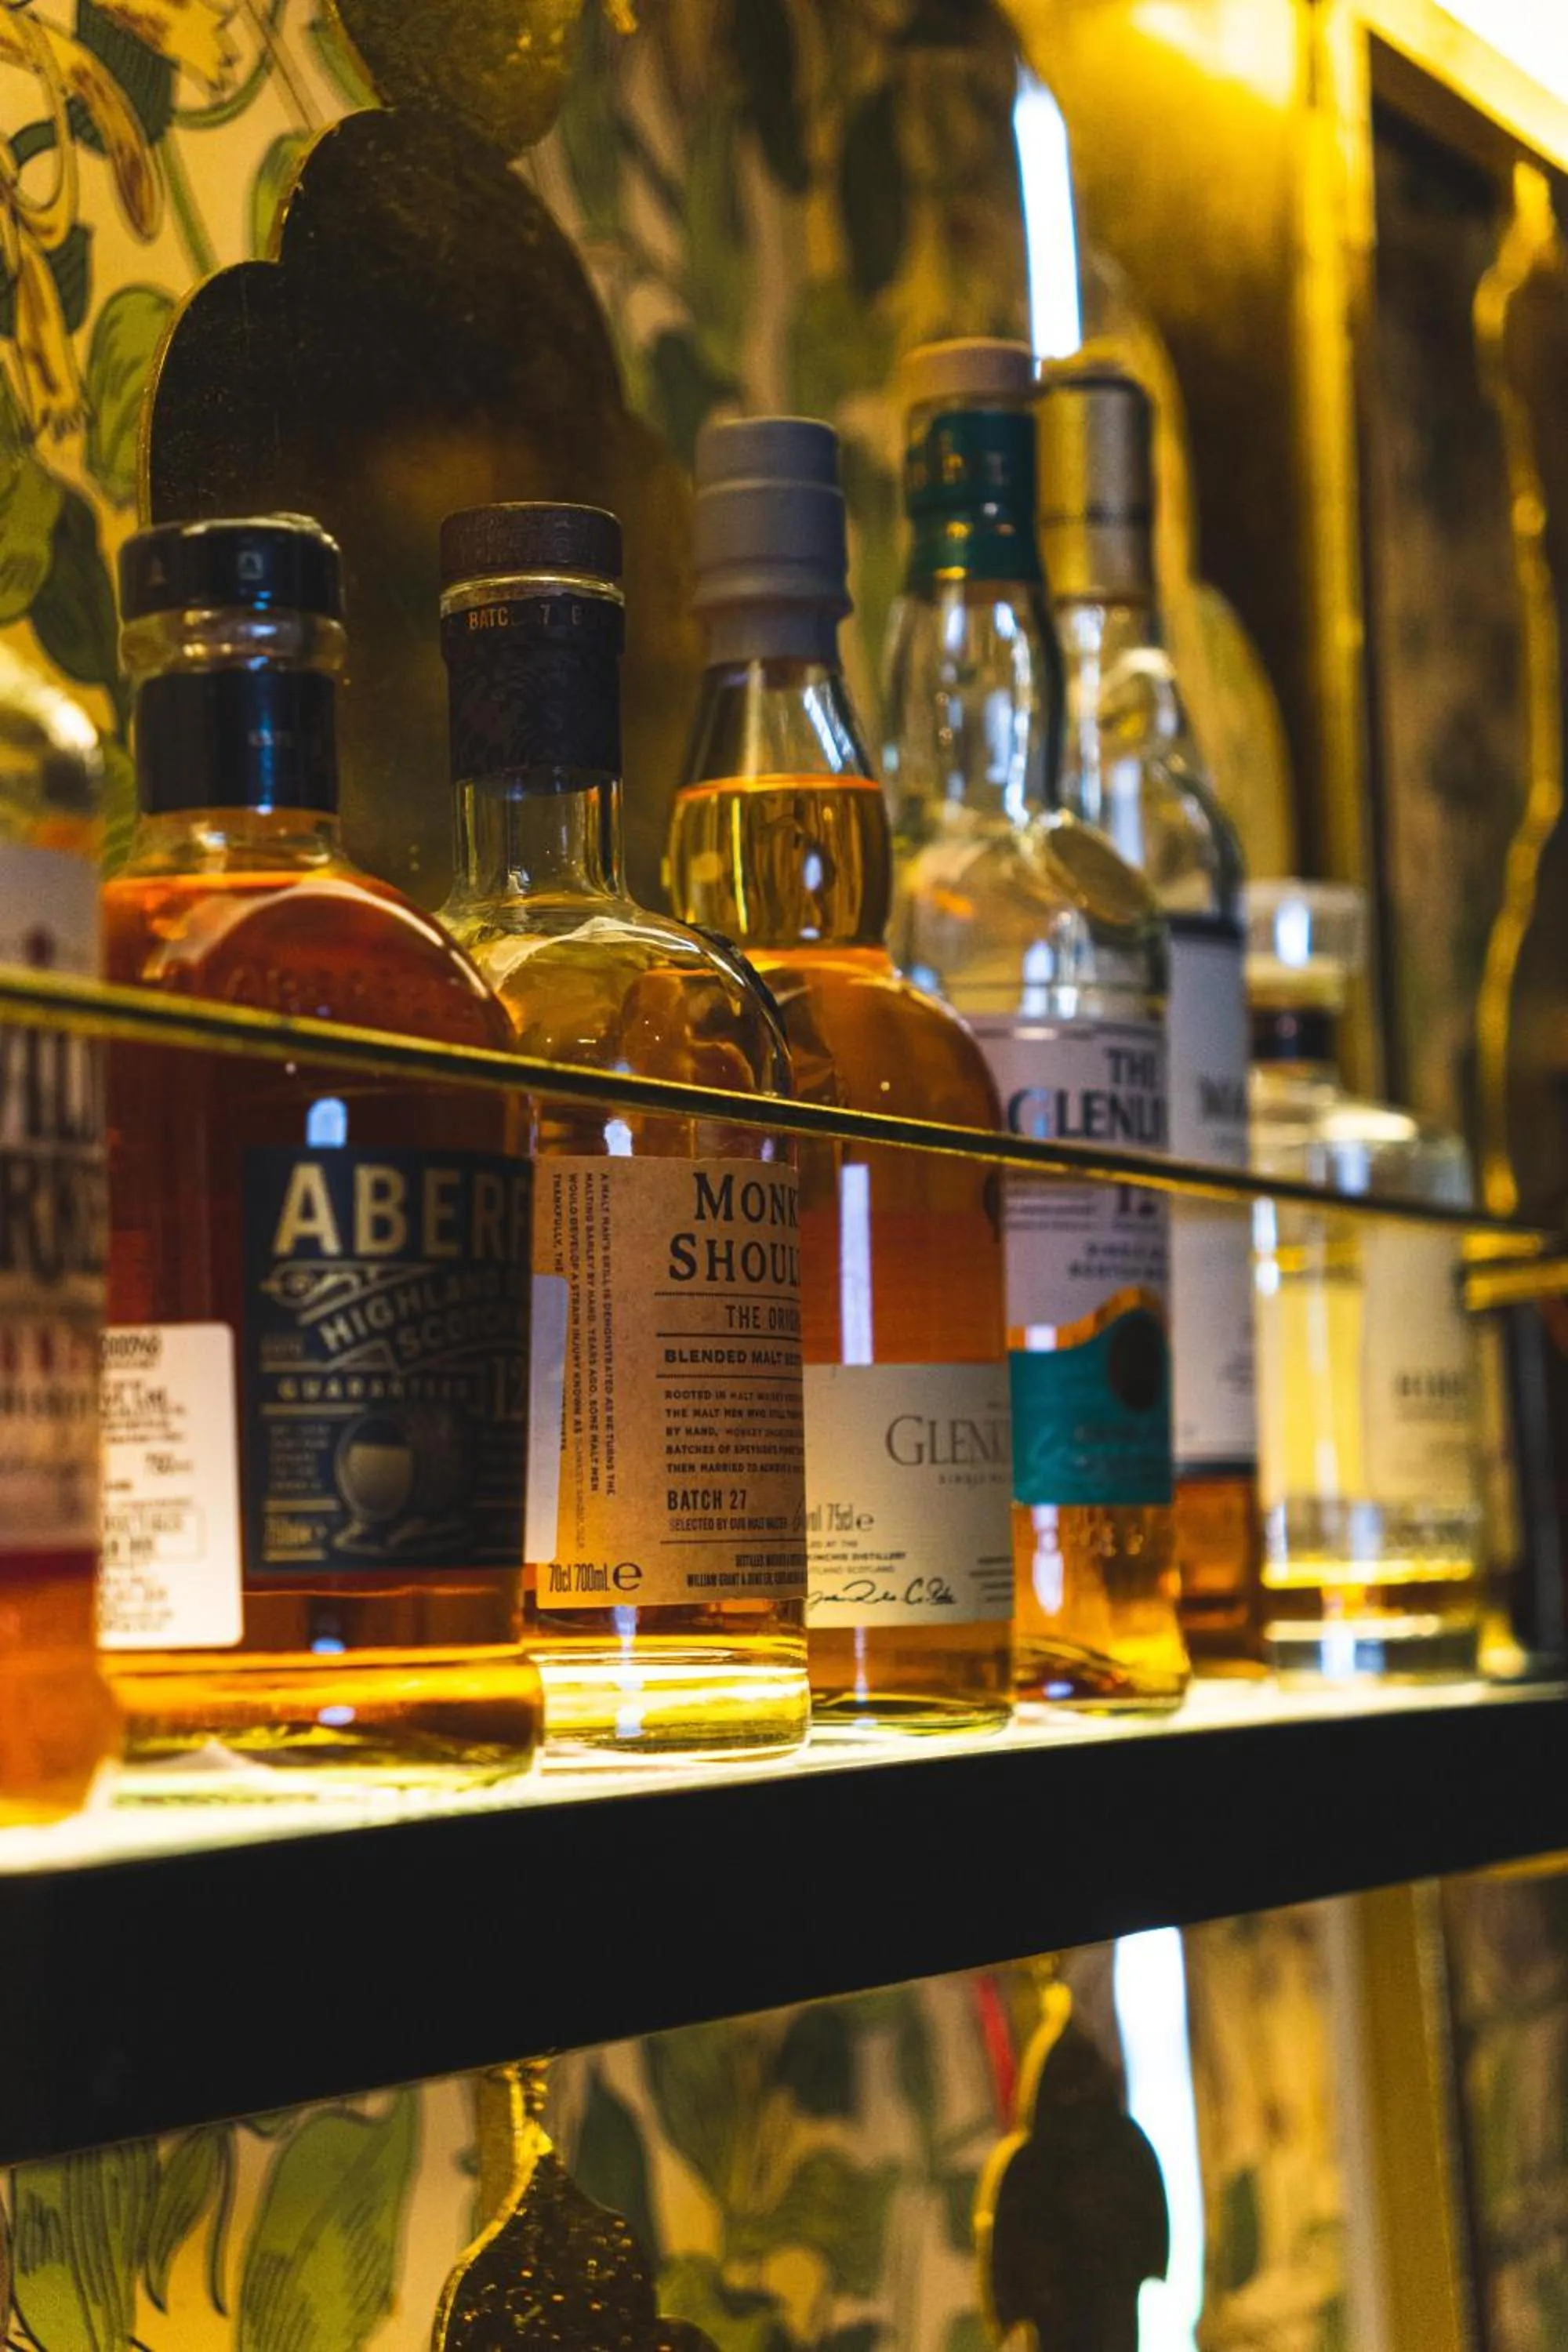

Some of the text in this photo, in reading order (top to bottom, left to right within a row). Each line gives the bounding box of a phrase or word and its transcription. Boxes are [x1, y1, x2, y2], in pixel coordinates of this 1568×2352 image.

[468, 606, 517, 630] BATC
[569, 1173, 579, 1215] WOULD
[585, 1173, 594, 1222] MALTING
[569, 1218, 579, 1270] DEVELOP
[586, 1272, 595, 1287] BY
[725, 1305, 761, 1329] THE
[571, 1328, 581, 1369] INJURY
[601, 1185, 610, 1212] MALT
[607, 1475, 615, 1497] THE
[664, 1348, 747, 1364] BLENDED
[752, 1350, 782, 1365] MALT
[664, 1389, 712, 1401] ROOTED
[715, 1390, 727, 1400] IN
[665, 1408, 688, 1419] THE
[693, 1408, 720, 1419] MALT
[724, 1408, 743, 1419] MEN
[666, 1426, 681, 1437] BY
[666, 1444, 715, 1455] BATCHES
[717, 1443, 731, 1454] OF
[666, 1463, 696, 1473] THEN
[700, 1462, 744, 1473] MARRIED
[667, 1489, 747, 1511] BATCH 27
[669, 1516, 714, 1532] SELECTED
[717, 1516, 728, 1531] BY
[730, 1516, 746, 1531] OUR
